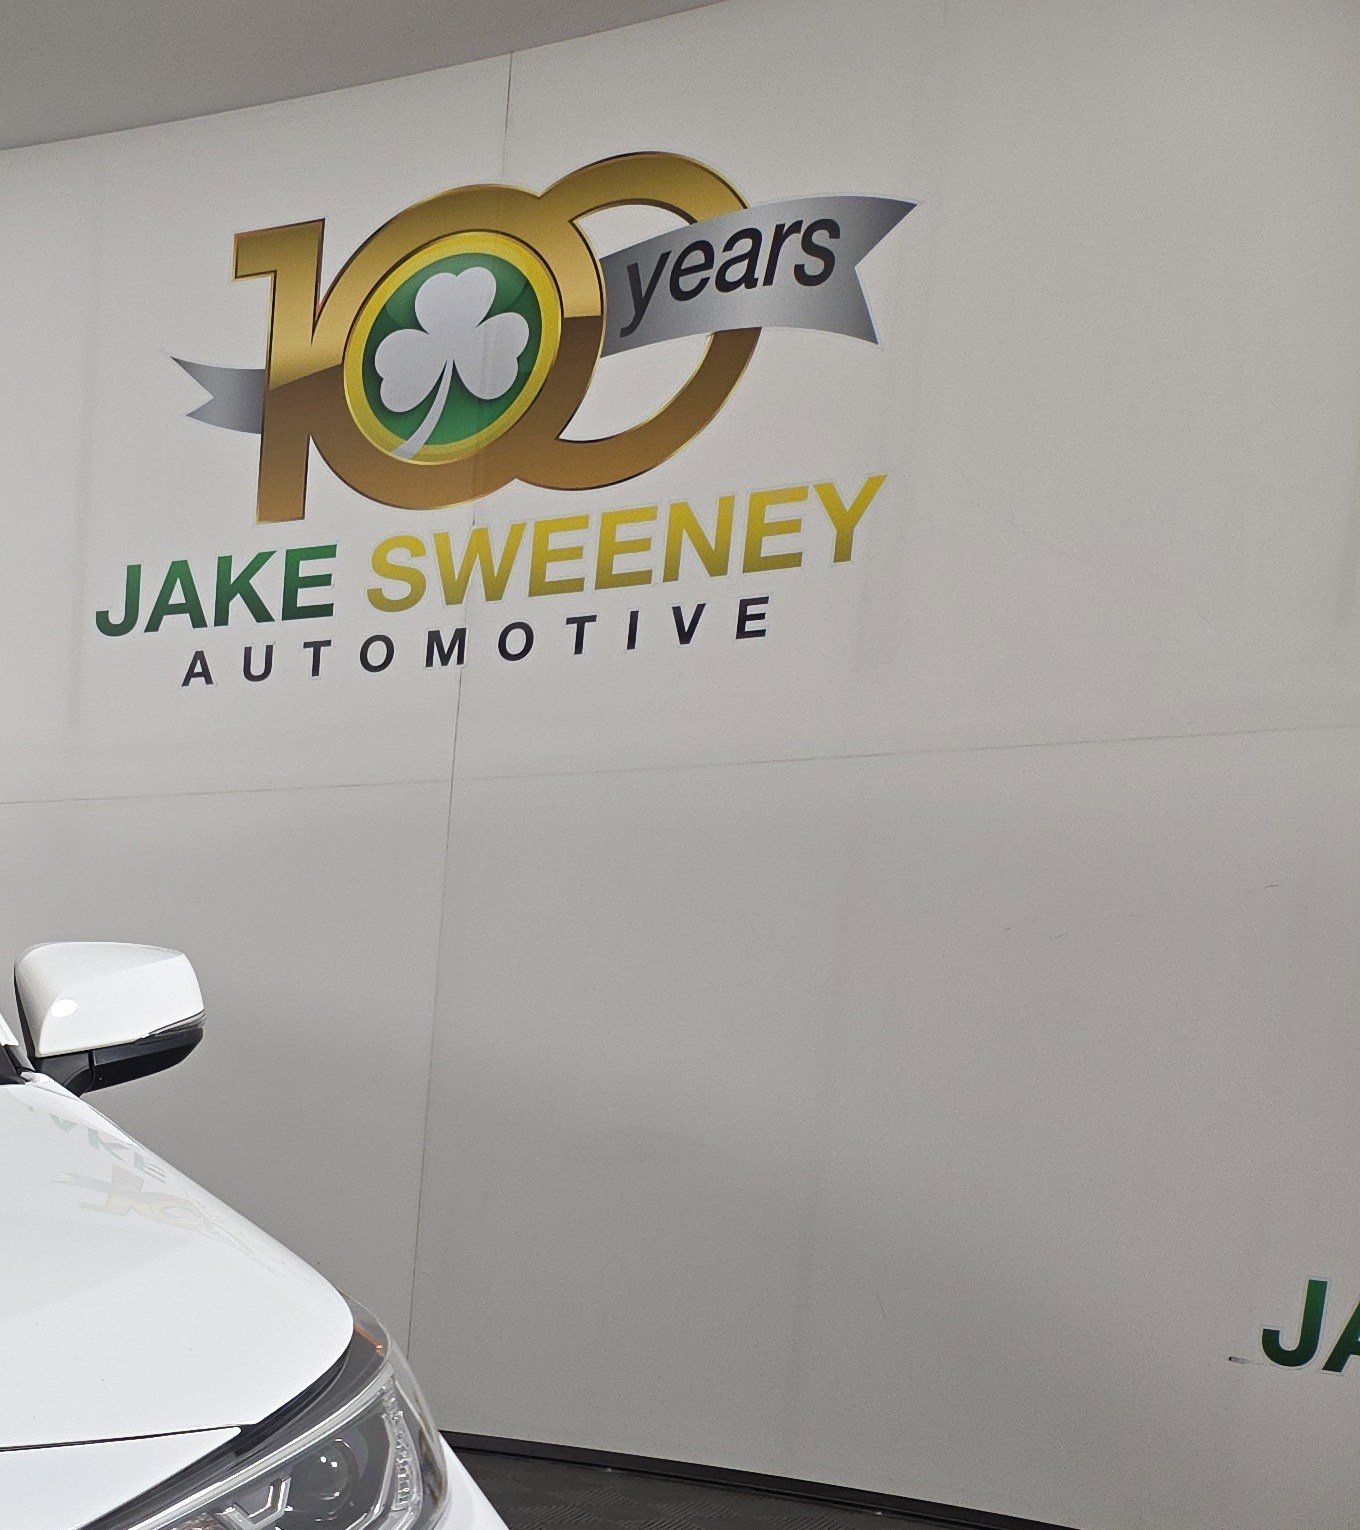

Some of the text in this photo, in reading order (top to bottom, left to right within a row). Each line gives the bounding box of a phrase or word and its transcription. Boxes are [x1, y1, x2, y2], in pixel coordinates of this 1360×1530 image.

[233, 150, 842, 523] 100 years
[95, 474, 887, 637] JAKE SWEENEY
[181, 596, 771, 687] AUTOMOTIVE
